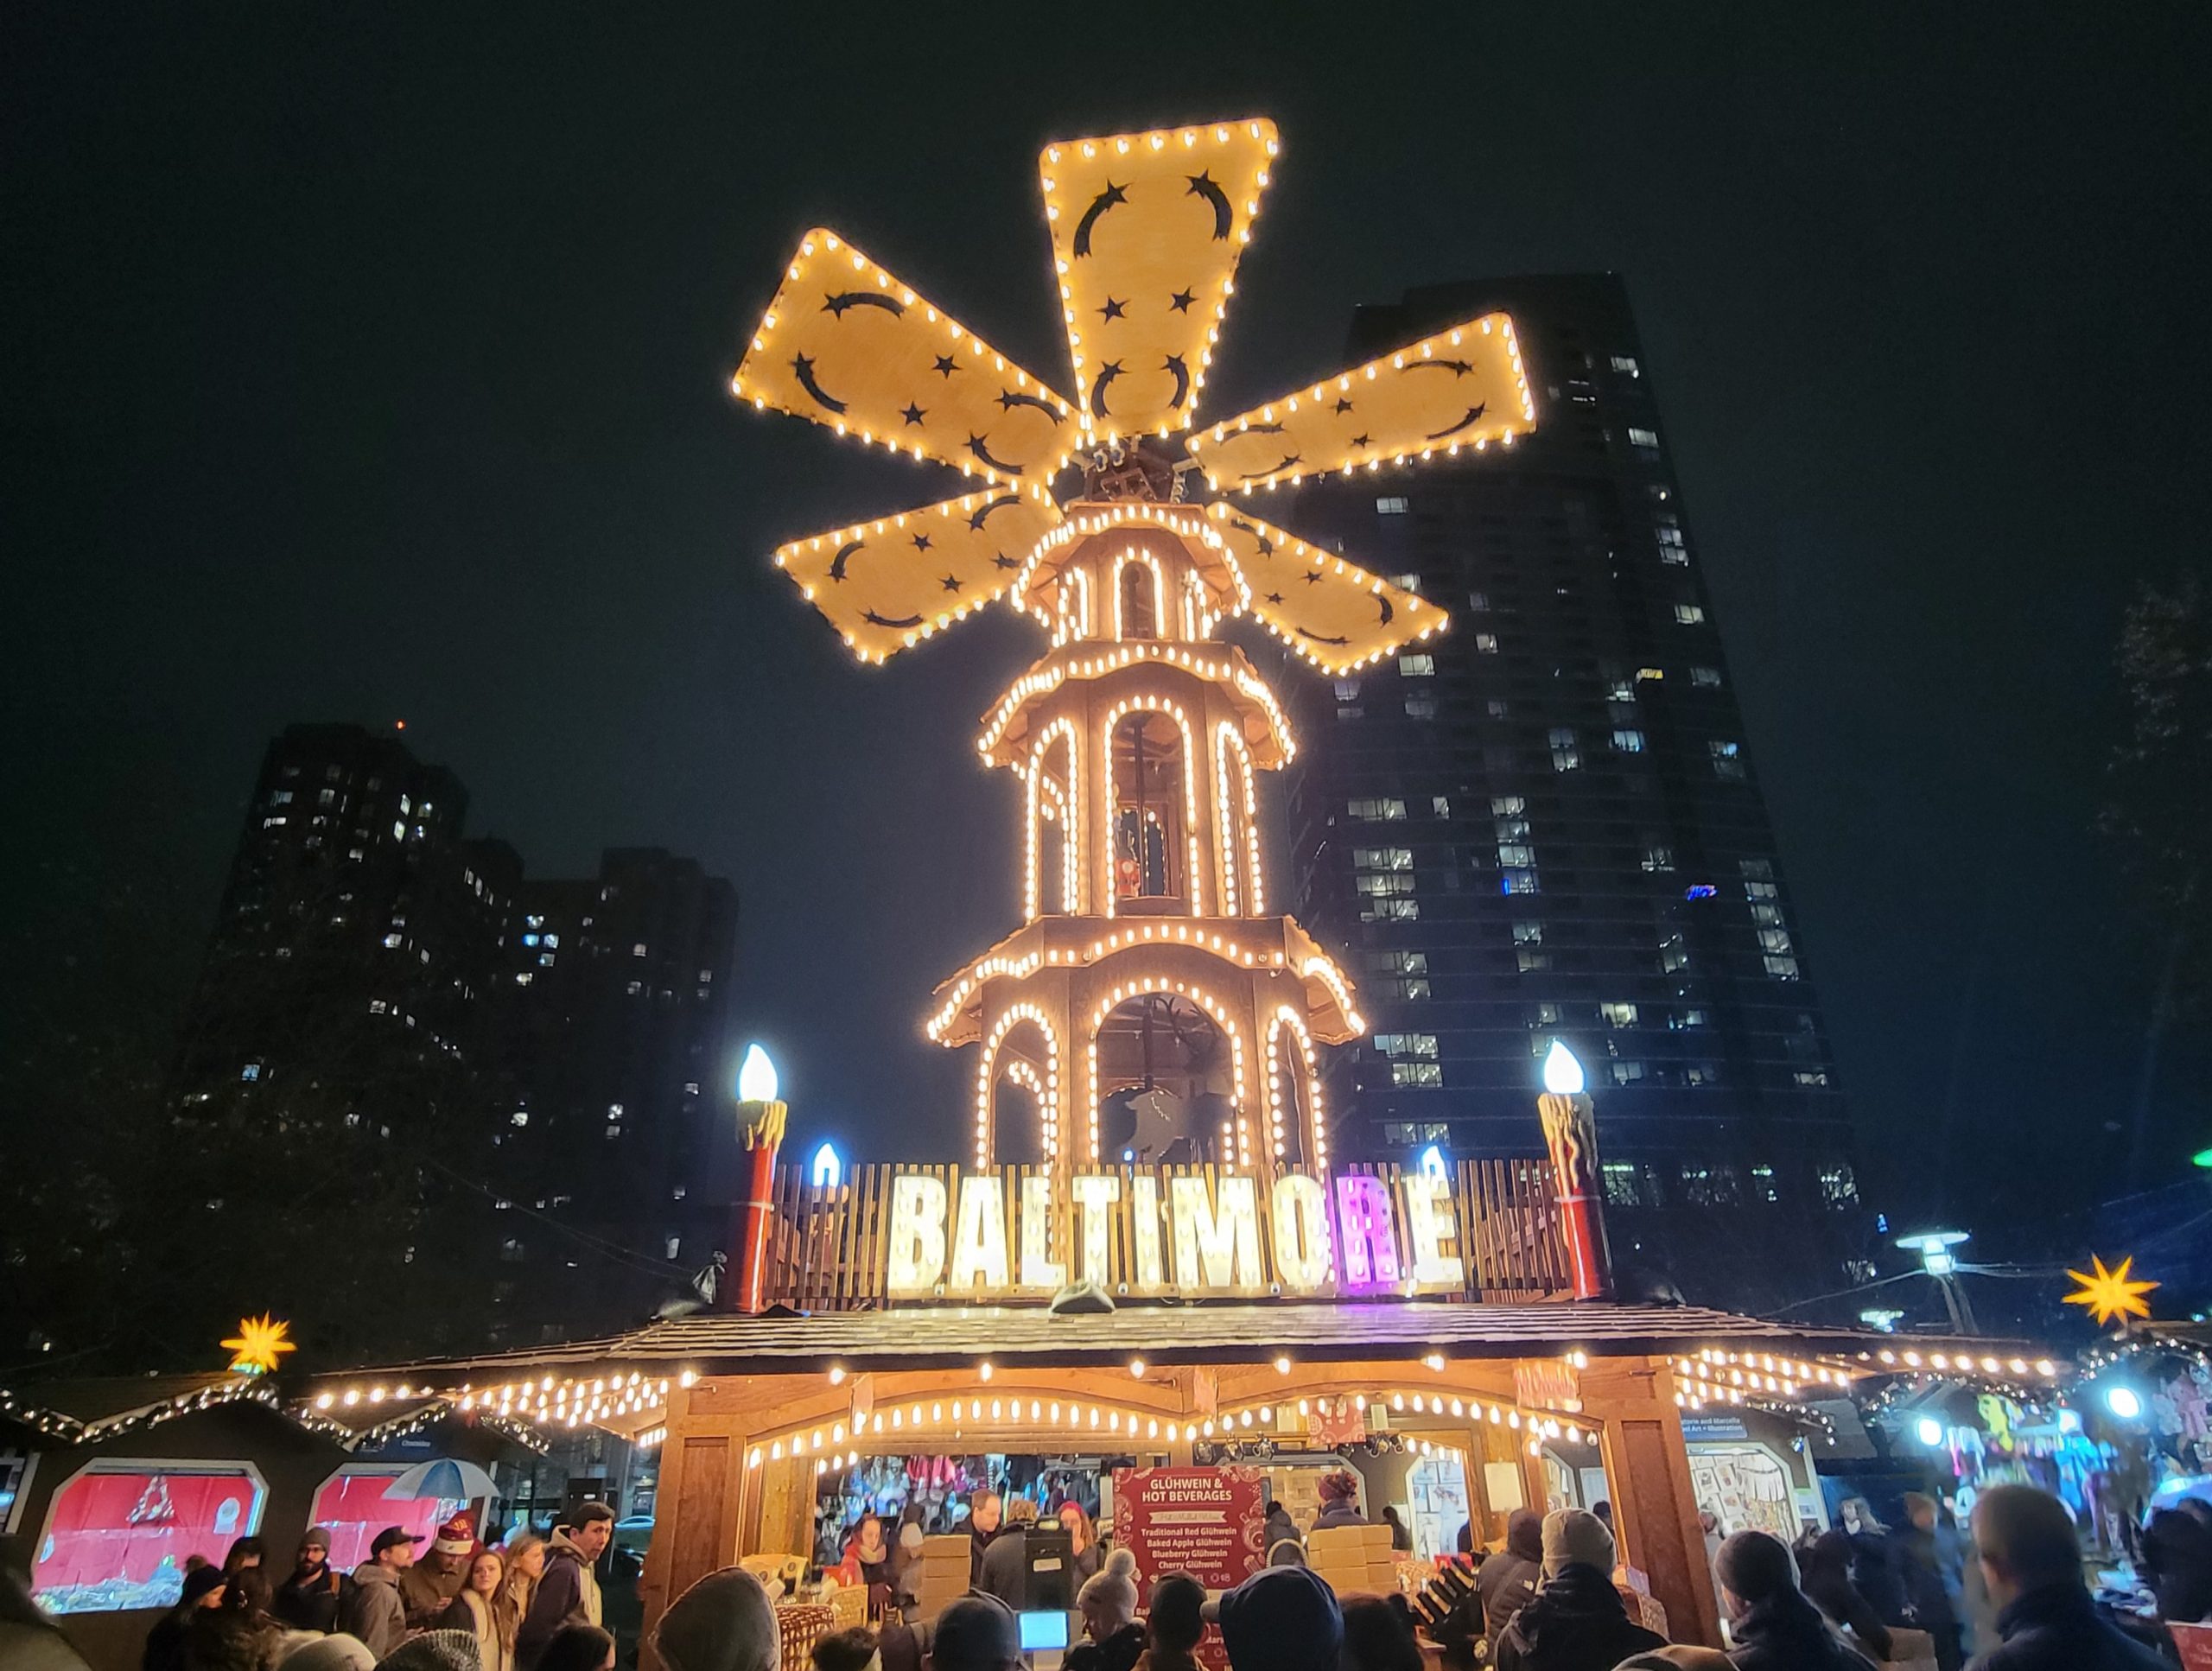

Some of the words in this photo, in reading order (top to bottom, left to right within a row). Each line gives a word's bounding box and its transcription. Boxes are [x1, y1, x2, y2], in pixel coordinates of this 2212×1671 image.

[887, 1174, 1465, 1291] BALTIMORE
[1150, 1477, 1211, 1490] GLÜHWEIN
[1214, 1477, 1224, 1489] &
[1141, 1491, 1166, 1503] HOT
[1168, 1490, 1232, 1502] BEVERAGES
[1141, 1528, 1184, 1537] Traditional
[1184, 1528, 1199, 1536] Red
[1200, 1527, 1237, 1535] Glühwein
[1147, 1539, 1172, 1547] Baked
[1172, 1539, 1195, 1548] Apple
[1195, 1537, 1232, 1547] Glühwein
[1152, 1550, 1191, 1560] Blueberry
[1191, 1548, 1229, 1557] Glühwein
[1158, 1560, 1185, 1570] Cherry
[1185, 1560, 1223, 1569] Glühwein
